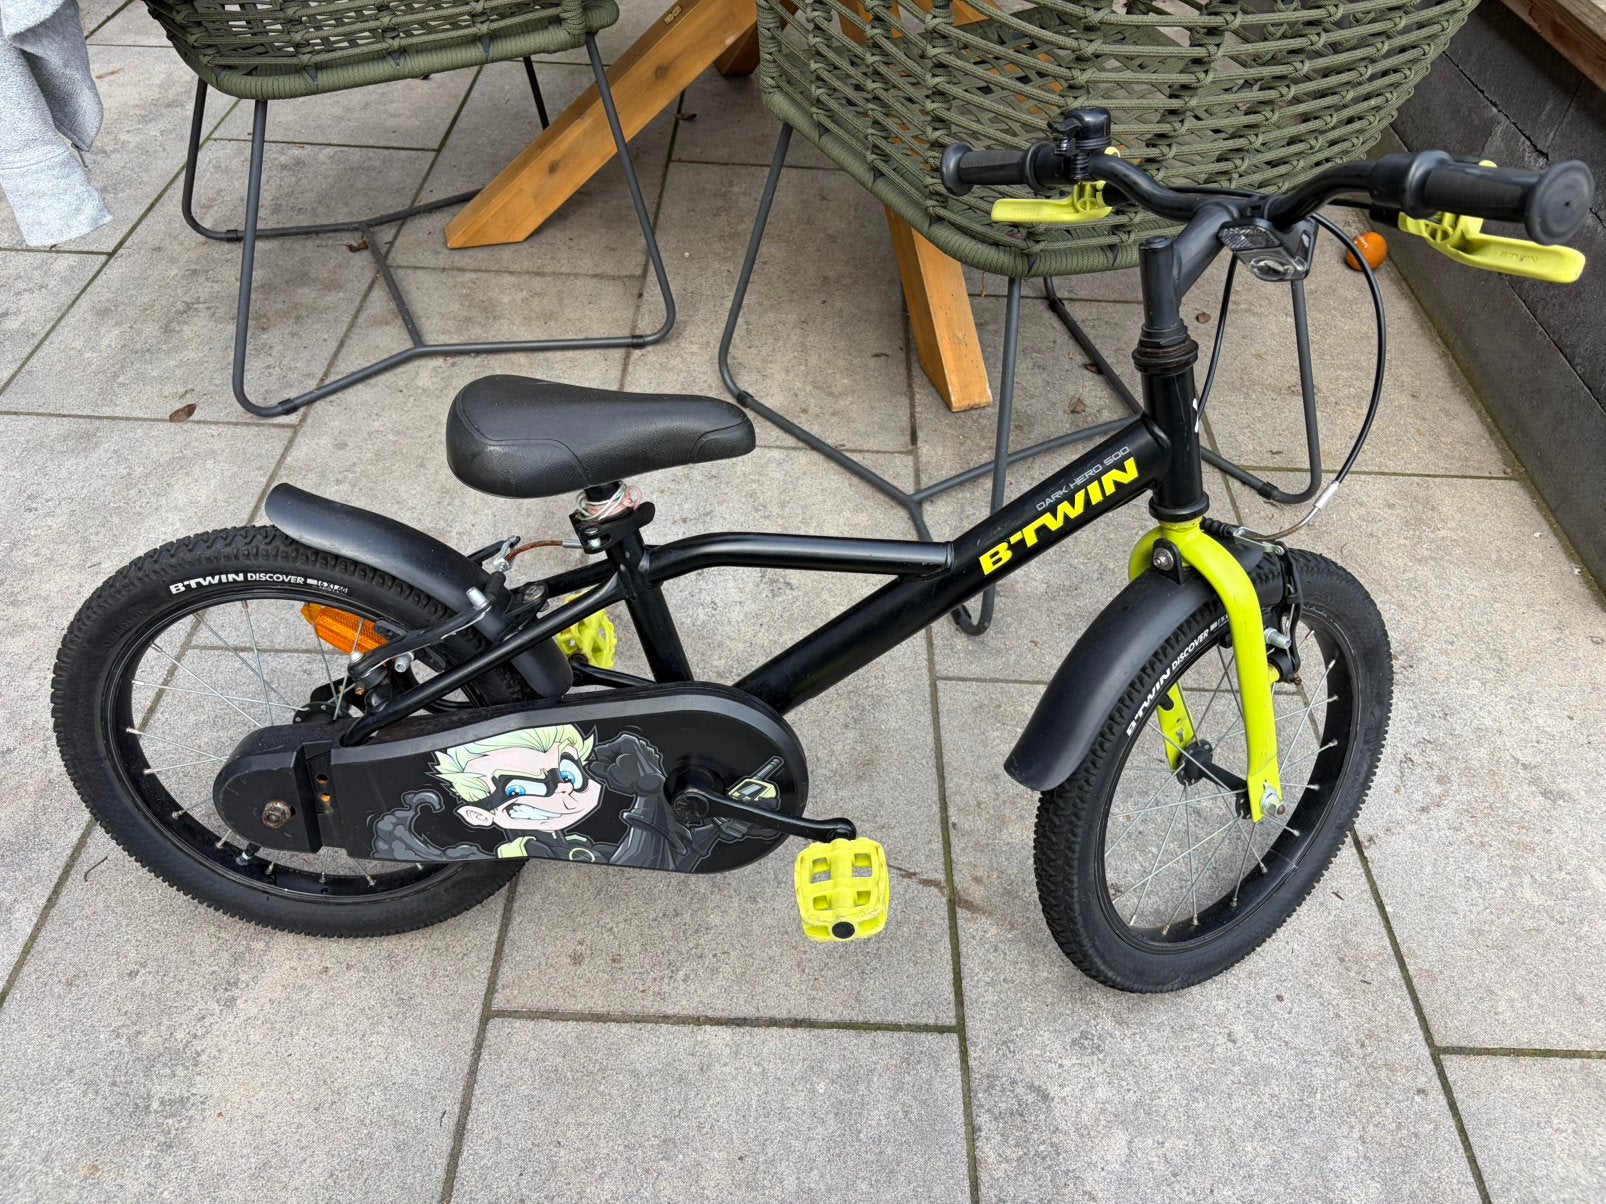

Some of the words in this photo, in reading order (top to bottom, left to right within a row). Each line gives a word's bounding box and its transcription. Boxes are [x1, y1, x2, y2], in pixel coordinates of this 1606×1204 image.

[1036, 485, 1069, 511] DARK
[1069, 464, 1103, 489] HERO
[1103, 446, 1130, 466] 500
[247, 573, 305, 585] DISCOVER
[1171, 629, 1209, 671] DISCOVER
